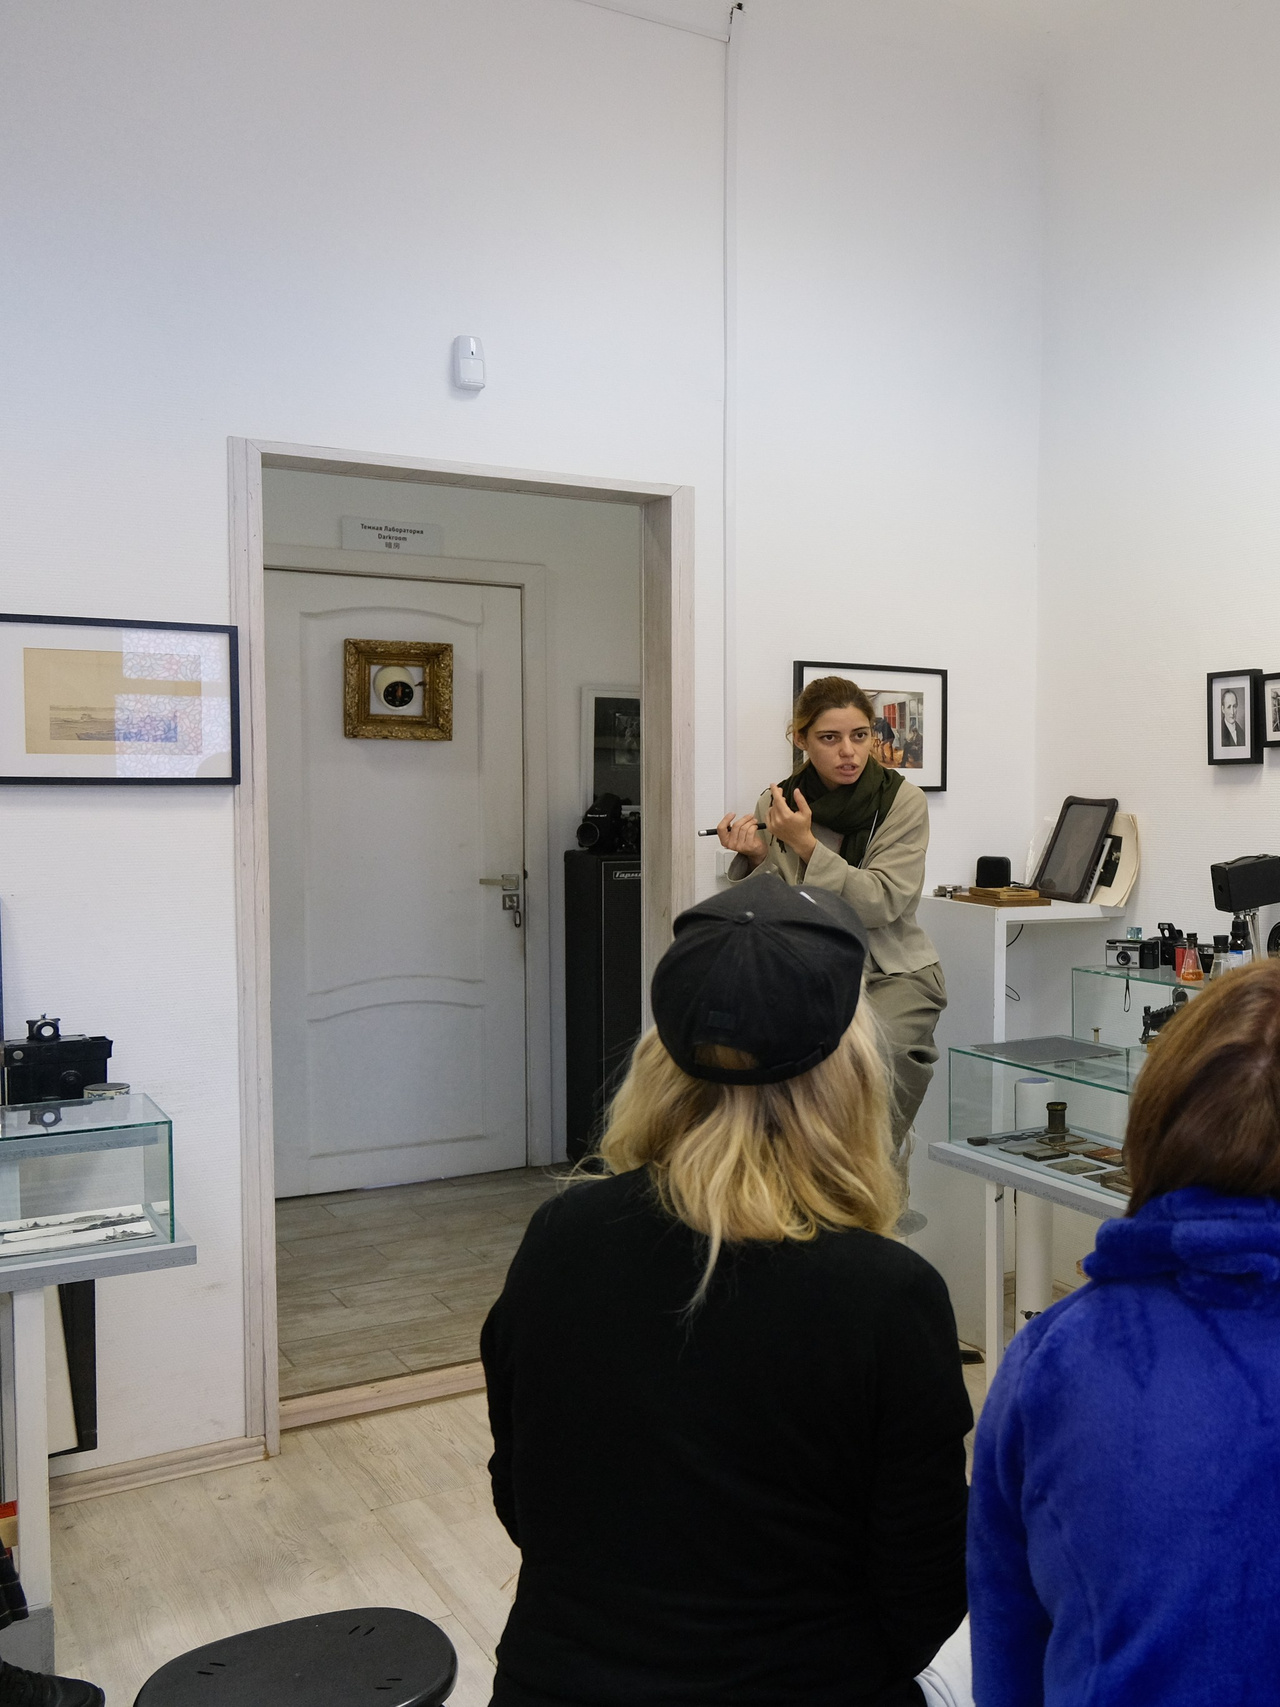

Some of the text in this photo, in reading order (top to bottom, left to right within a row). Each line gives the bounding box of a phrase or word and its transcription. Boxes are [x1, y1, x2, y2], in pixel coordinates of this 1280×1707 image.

[361, 523, 424, 534] Темная Лаборатория
[378, 533, 407, 541] Darkroom
